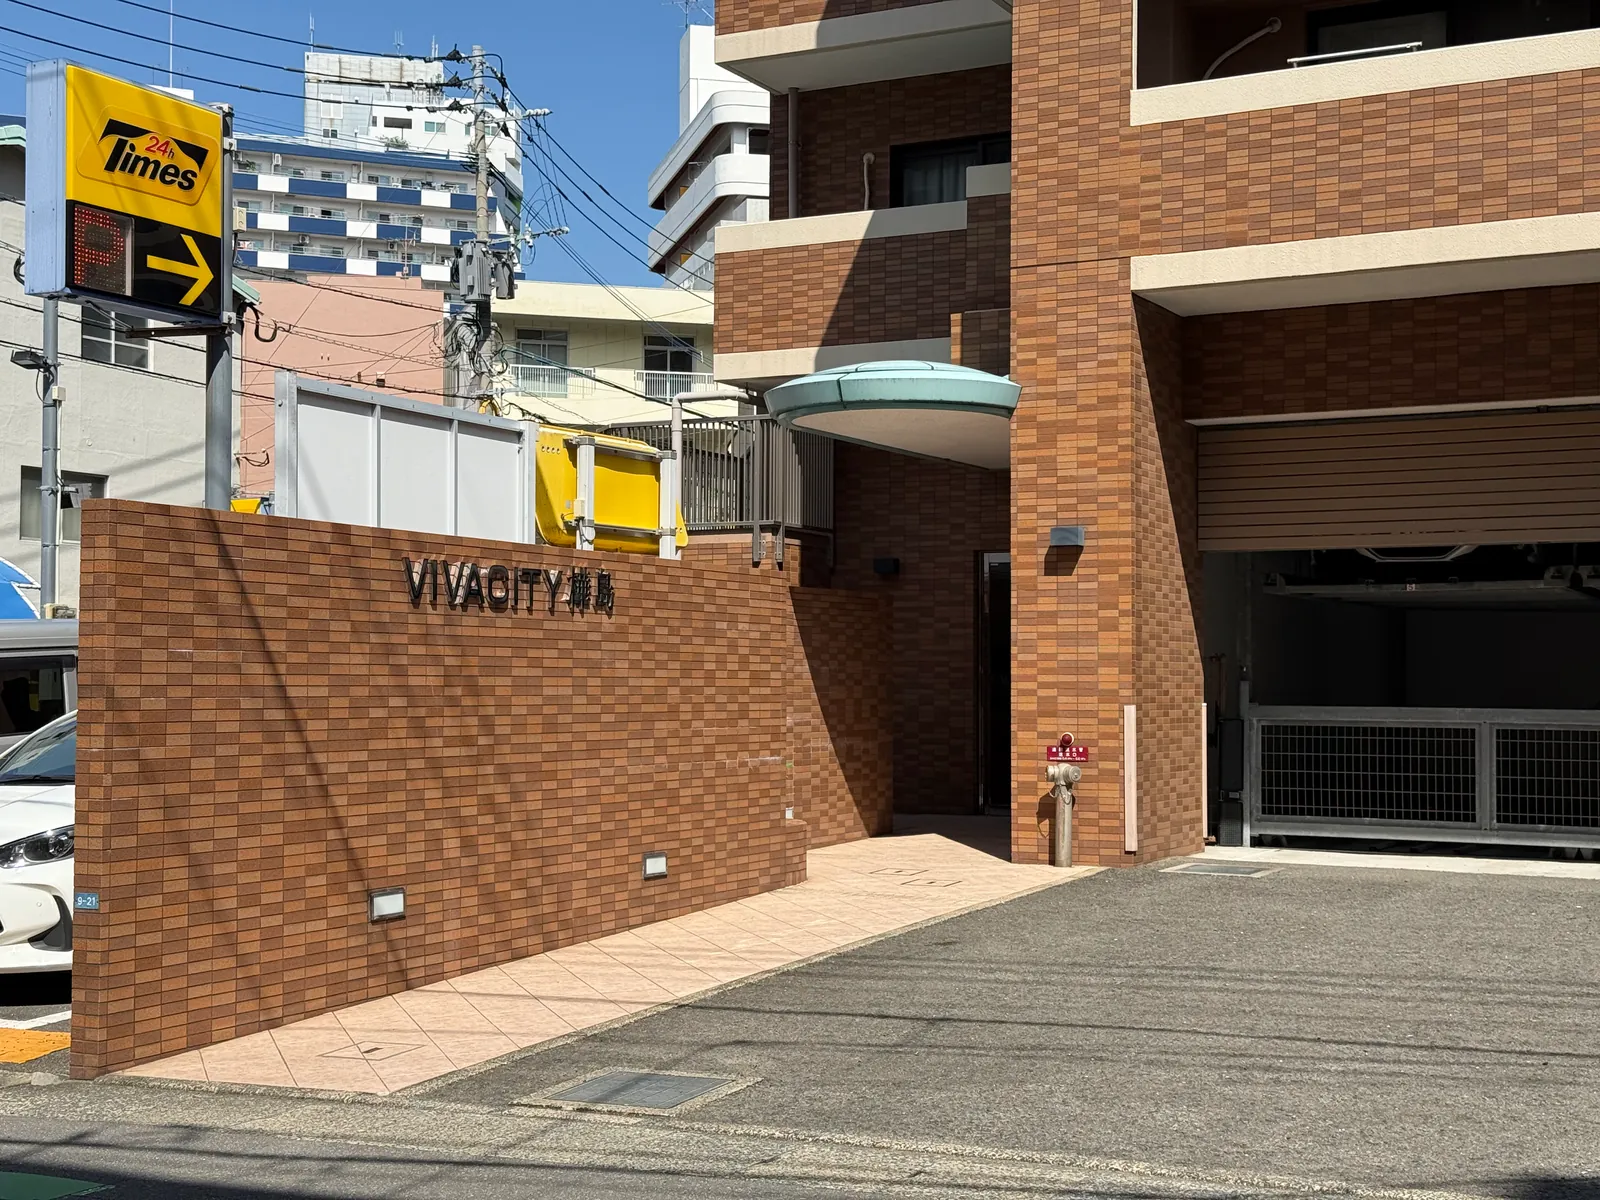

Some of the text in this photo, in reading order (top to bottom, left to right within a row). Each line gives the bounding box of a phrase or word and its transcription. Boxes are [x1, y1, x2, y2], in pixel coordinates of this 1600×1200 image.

[103, 135, 198, 190] Times
[145, 136, 175, 159] 24h
[73, 204, 125, 285] P
[77, 896, 96, 906] 9-21
